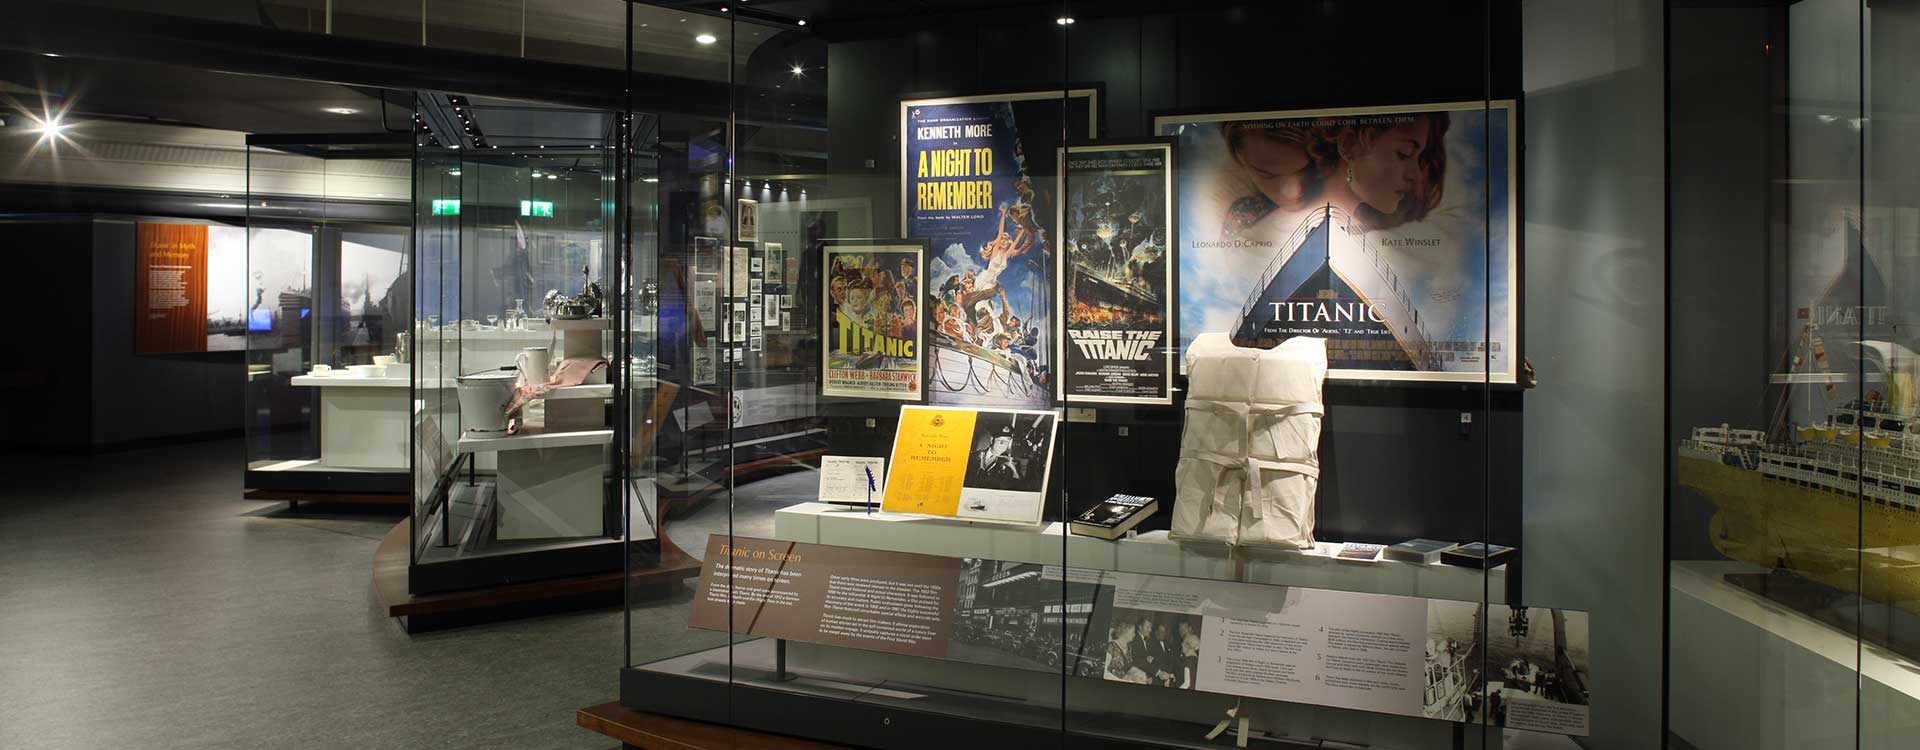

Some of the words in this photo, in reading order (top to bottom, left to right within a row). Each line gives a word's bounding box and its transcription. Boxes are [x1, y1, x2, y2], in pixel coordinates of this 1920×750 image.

[917, 126, 962, 140] KENNETH
[965, 124, 993, 138] MORE
[1242, 122, 1274, 130] NOTHING
[1359, 118, 1392, 126] BETWEEN
[918, 150, 928, 178] A
[931, 149, 972, 178] NIGHT
[973, 148, 993, 176] TO
[917, 180, 994, 210] REMEMBER
[1192, 240, 1232, 248] LEONARDO
[1382, 238, 1404, 246] KATE
[1404, 238, 1440, 246] WINSLET
[1268, 302, 1386, 322] TITANIC
[836, 308, 914, 358] TITANIC
[1068, 330, 1122, 340] RAISE
[1126, 330, 1162, 340] THE
[1073, 340, 1154, 361] TITANIC
[850, 370, 866, 380] WEBB
[869, 370, 892, 381] BARBARA
[720, 544, 750, 558] Tianic
[752, 550, 766, 559] on
[768, 549, 802, 563] Screen
